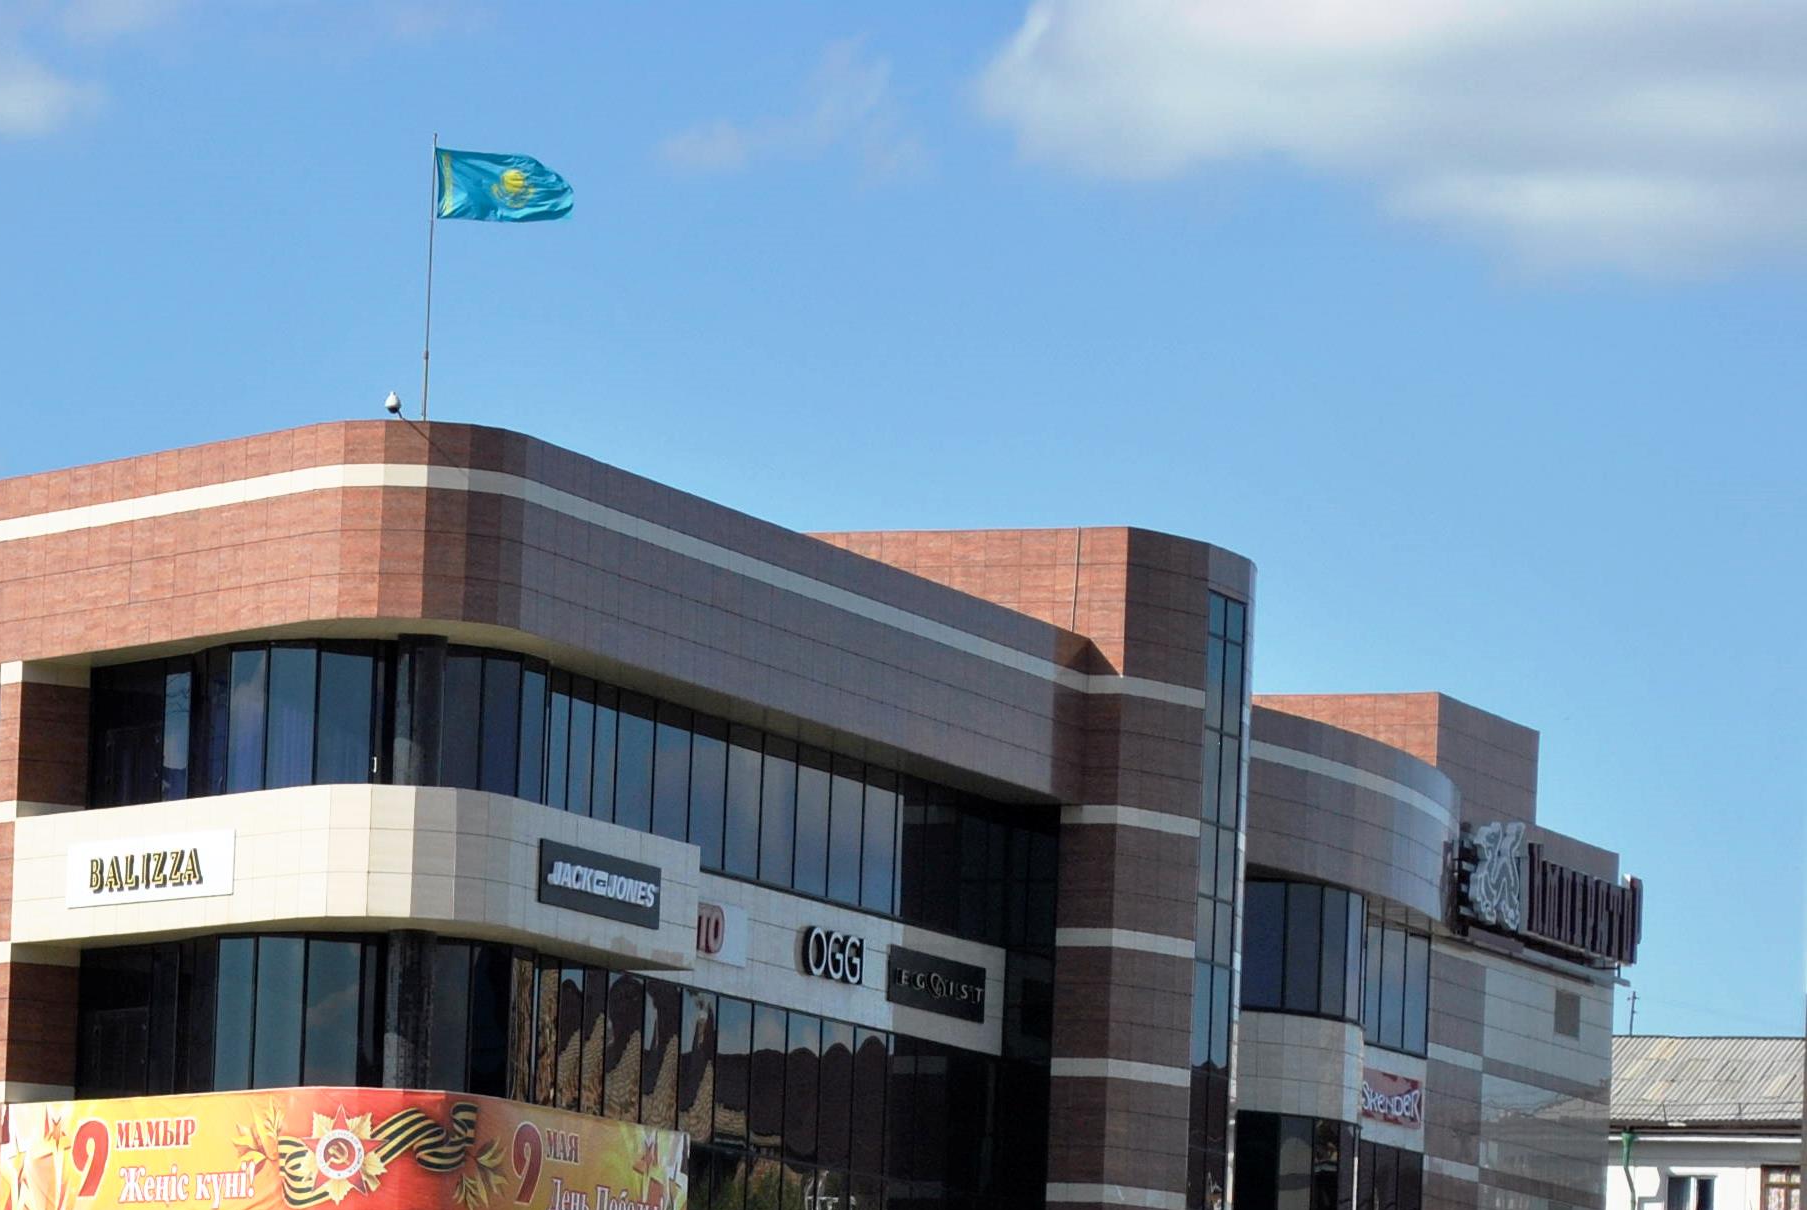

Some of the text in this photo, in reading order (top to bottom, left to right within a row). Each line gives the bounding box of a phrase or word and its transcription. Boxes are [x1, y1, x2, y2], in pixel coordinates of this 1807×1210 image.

[89, 848, 203, 893] BALIZZA
[805, 926, 865, 984] OGGI
[72, 1118, 196, 1198] 9 МАМЫР
[119, 1164, 191, 1207] Жеңіс
[512, 1121, 580, 1205] 9 МАЯ
